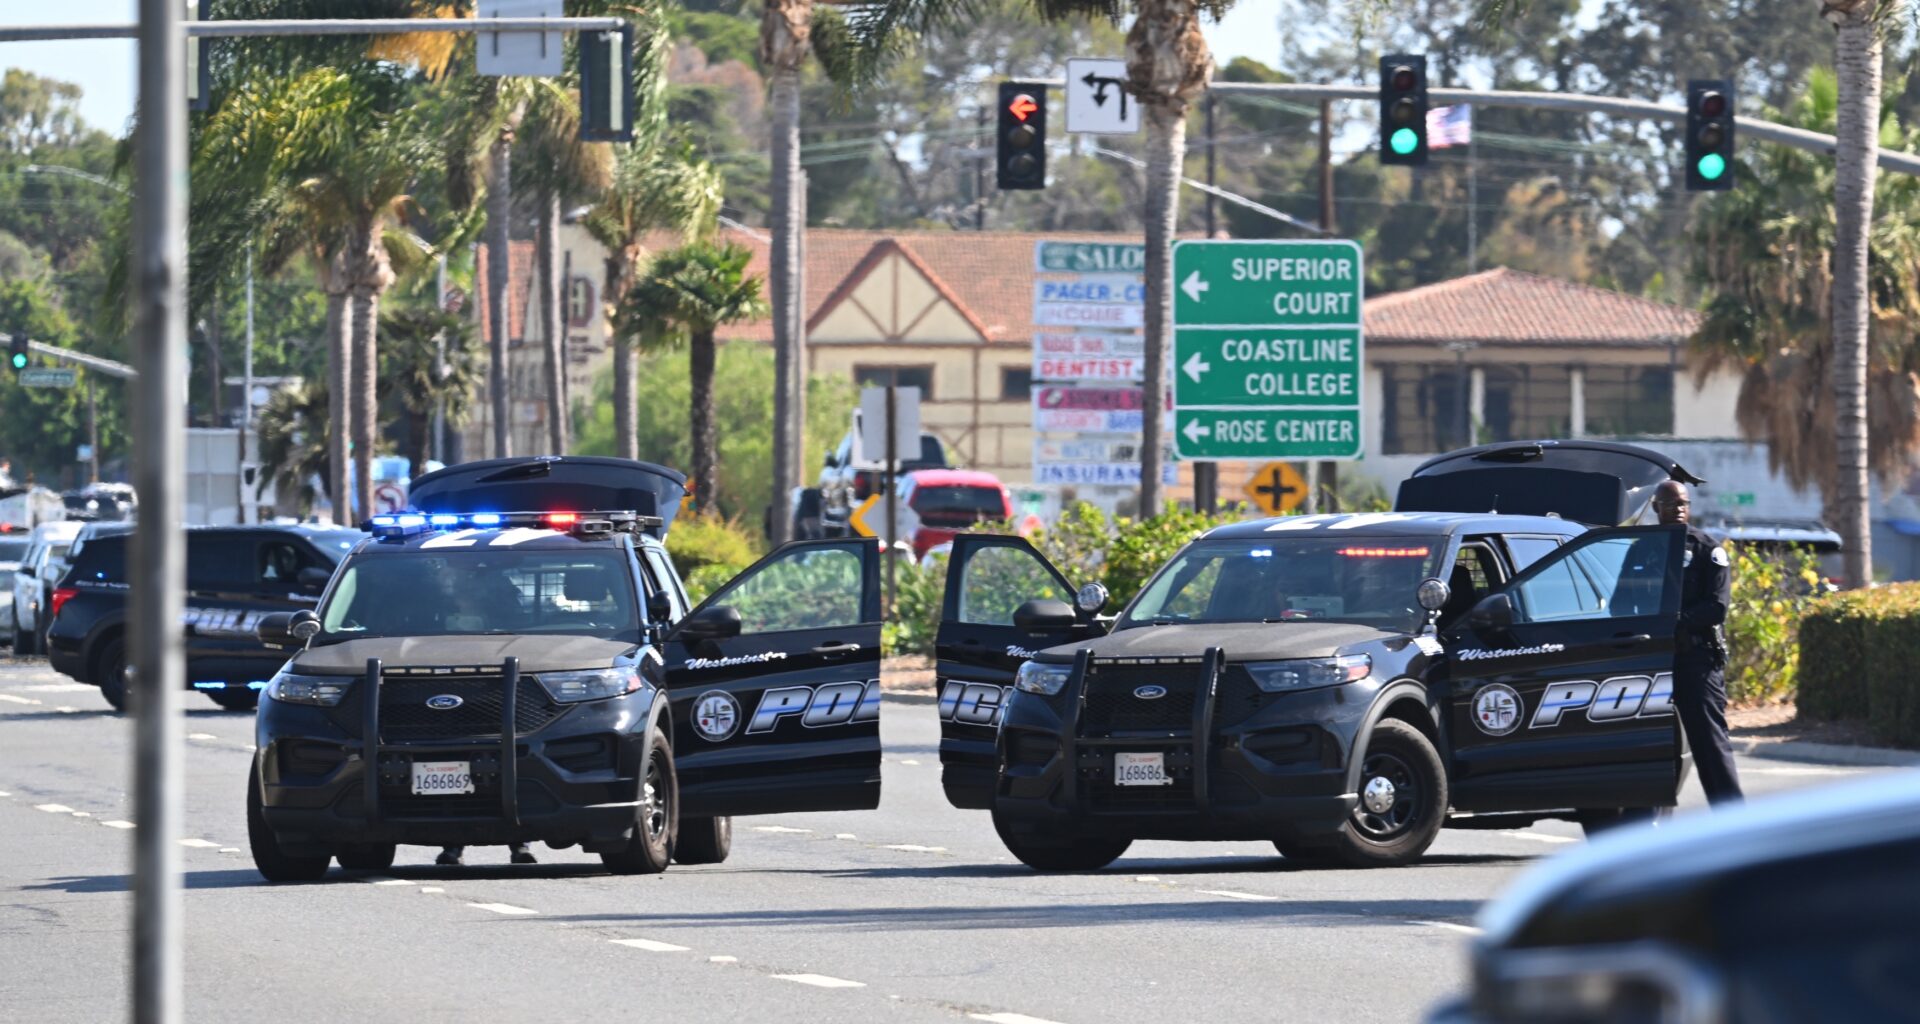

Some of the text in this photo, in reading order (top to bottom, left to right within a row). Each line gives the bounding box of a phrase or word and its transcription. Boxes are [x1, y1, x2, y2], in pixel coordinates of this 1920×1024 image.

[1231, 258, 1352, 281] SUPERIOR
[1273, 292, 1352, 315] COURT
[1221, 339, 1353, 362] COASTLINE
[1040, 361, 1133, 377] DENTIST
[1245, 373, 1353, 396] COLLEGE
[1215, 419, 1353, 443] ROSE CENTER
[1040, 464, 1171, 484] INSURANE
[684, 651, 787, 670] Westminster
[1457, 642, 1565, 660] Westminster
[416, 774, 471, 789] 1686869
